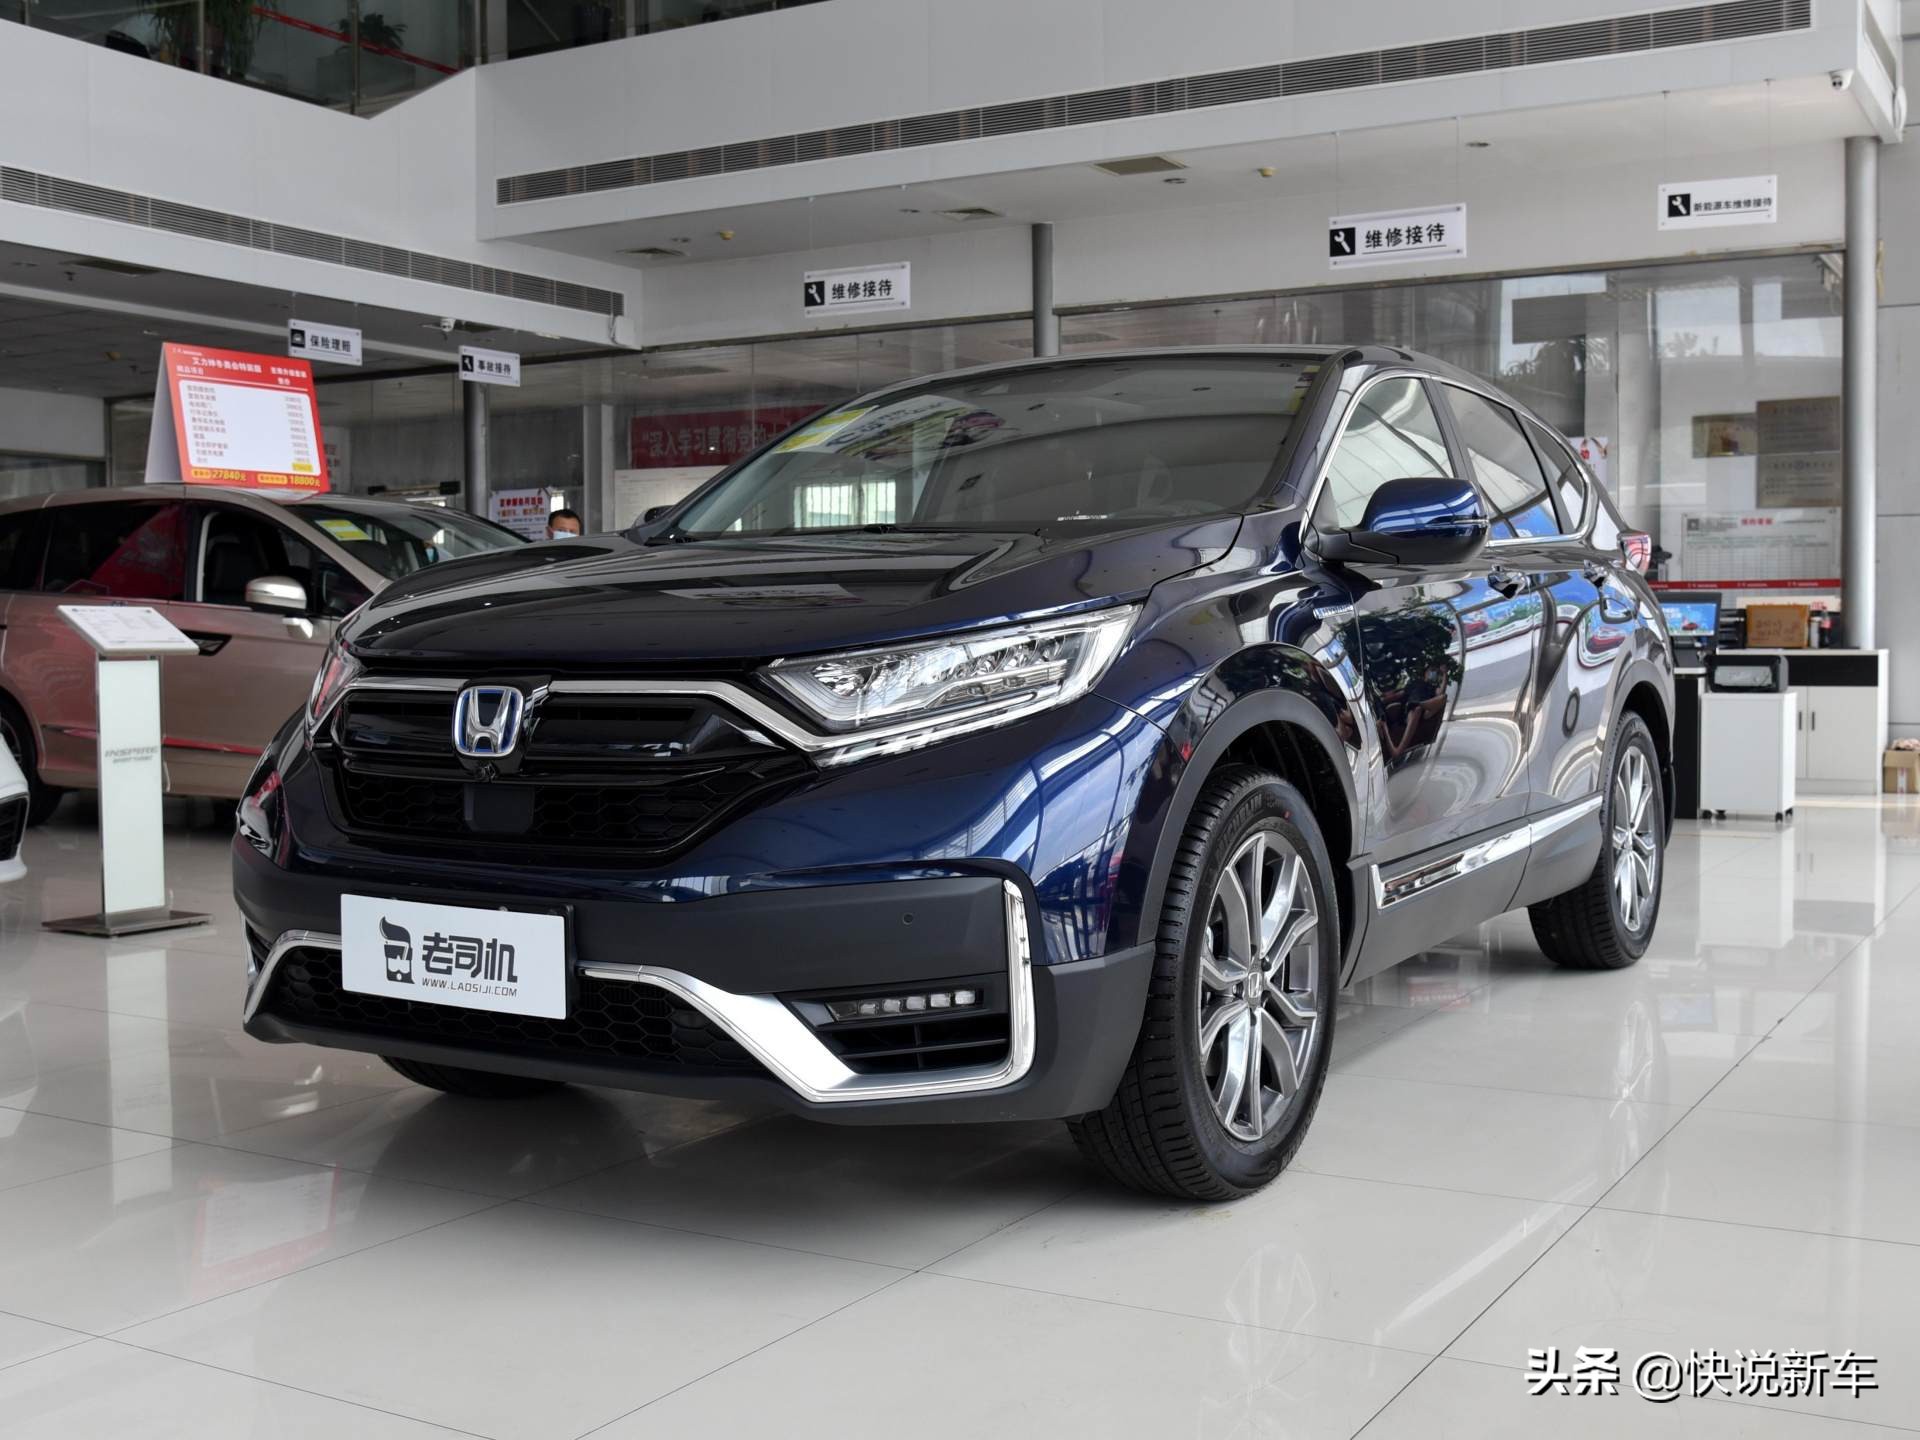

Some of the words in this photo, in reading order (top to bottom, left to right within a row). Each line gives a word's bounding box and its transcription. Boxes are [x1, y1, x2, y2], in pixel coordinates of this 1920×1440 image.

[1694, 197, 1772, 212] 新能源车维修接待
[1365, 223, 1445, 249] 维修接待
[832, 279, 893, 300] 维修接待
[310, 335, 351, 353] 保险理赔
[477, 359, 512, 376] 事故接待
[422, 932, 518, 984] 老司机
[422, 977, 518, 998] WWW.LAOSIJI.COM
